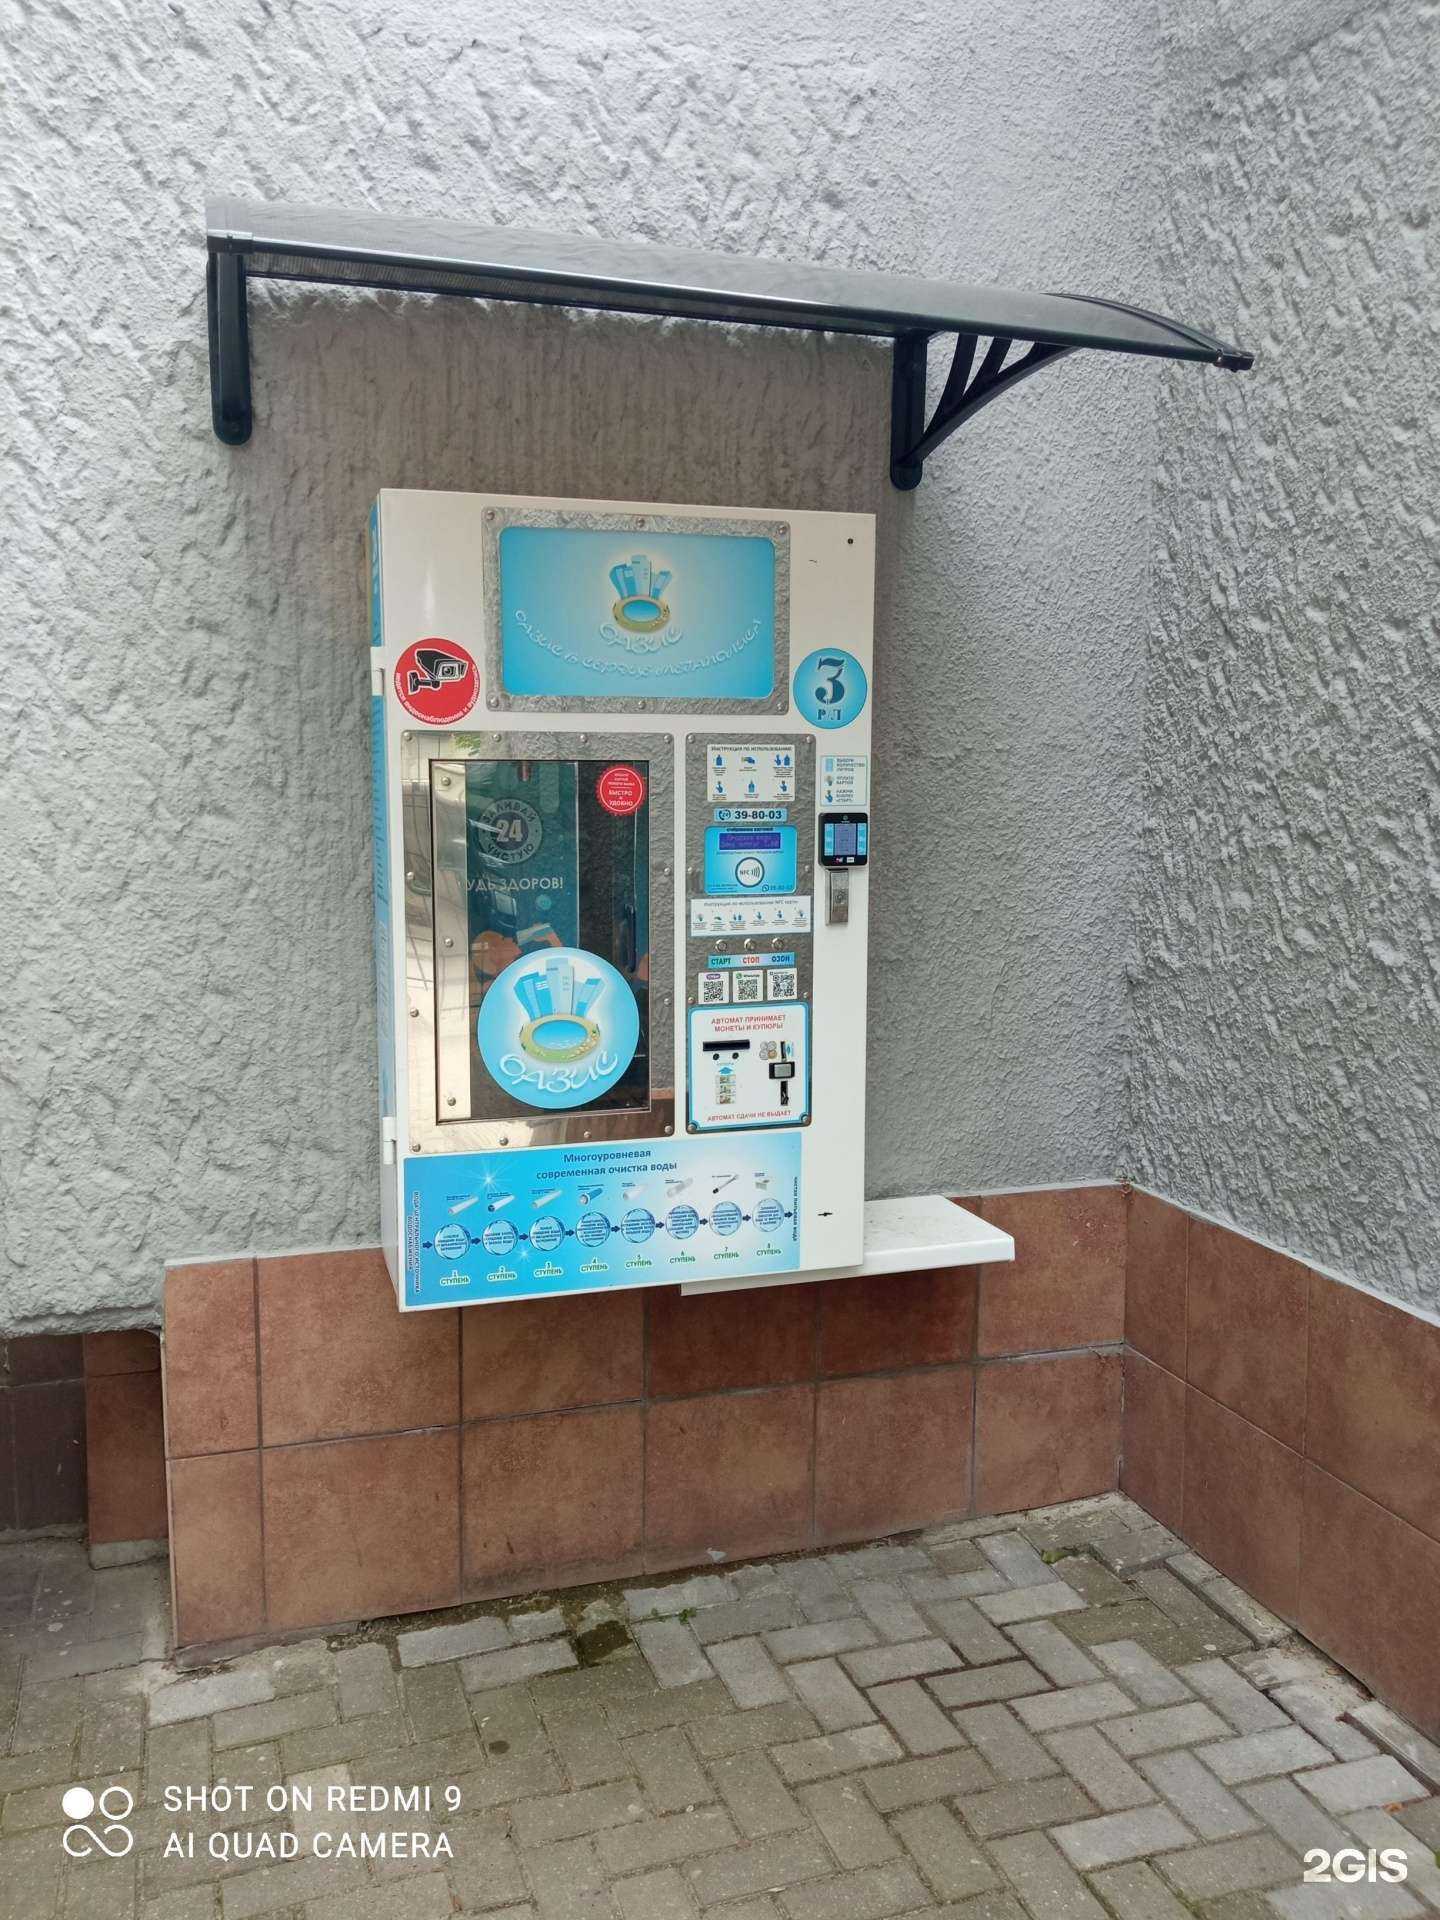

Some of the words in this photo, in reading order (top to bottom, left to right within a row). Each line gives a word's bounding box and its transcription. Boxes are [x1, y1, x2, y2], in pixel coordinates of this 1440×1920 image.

[815, 658, 845, 704] 3
[734, 810, 782, 820] 39-80-03
[496, 819, 523, 842] 24
[465, 879, 496, 892] УДЬ
[501, 877, 563, 892] ЗДОРОВ!
[711, 957, 731, 966] СТАРТ
[742, 956, 760, 964] СТОП
[771, 955, 790, 963] ОЗОН
[711, 1017, 744, 1025] АВТОМАТ
[744, 1014, 787, 1023] ПРИНИМАЕТ
[752, 1022, 784, 1030] КУПЮРЫ
[707, 1114, 735, 1122] АВТОМАТ
[564, 1150, 651, 1163] Многоуровневая
[536, 1167, 606, 1181] современная
[608, 1164, 648, 1175] очистка
[650, 1162, 678, 1172] воды
[534, 1268, 562, 1276] СТУПЕНЬ
[580, 1264, 608, 1272] СТУПЕНЬ
[440, 1276, 469, 1285] СТУПЕНЬ
[488, 1272, 516, 1281] СТУПЕНЬ
